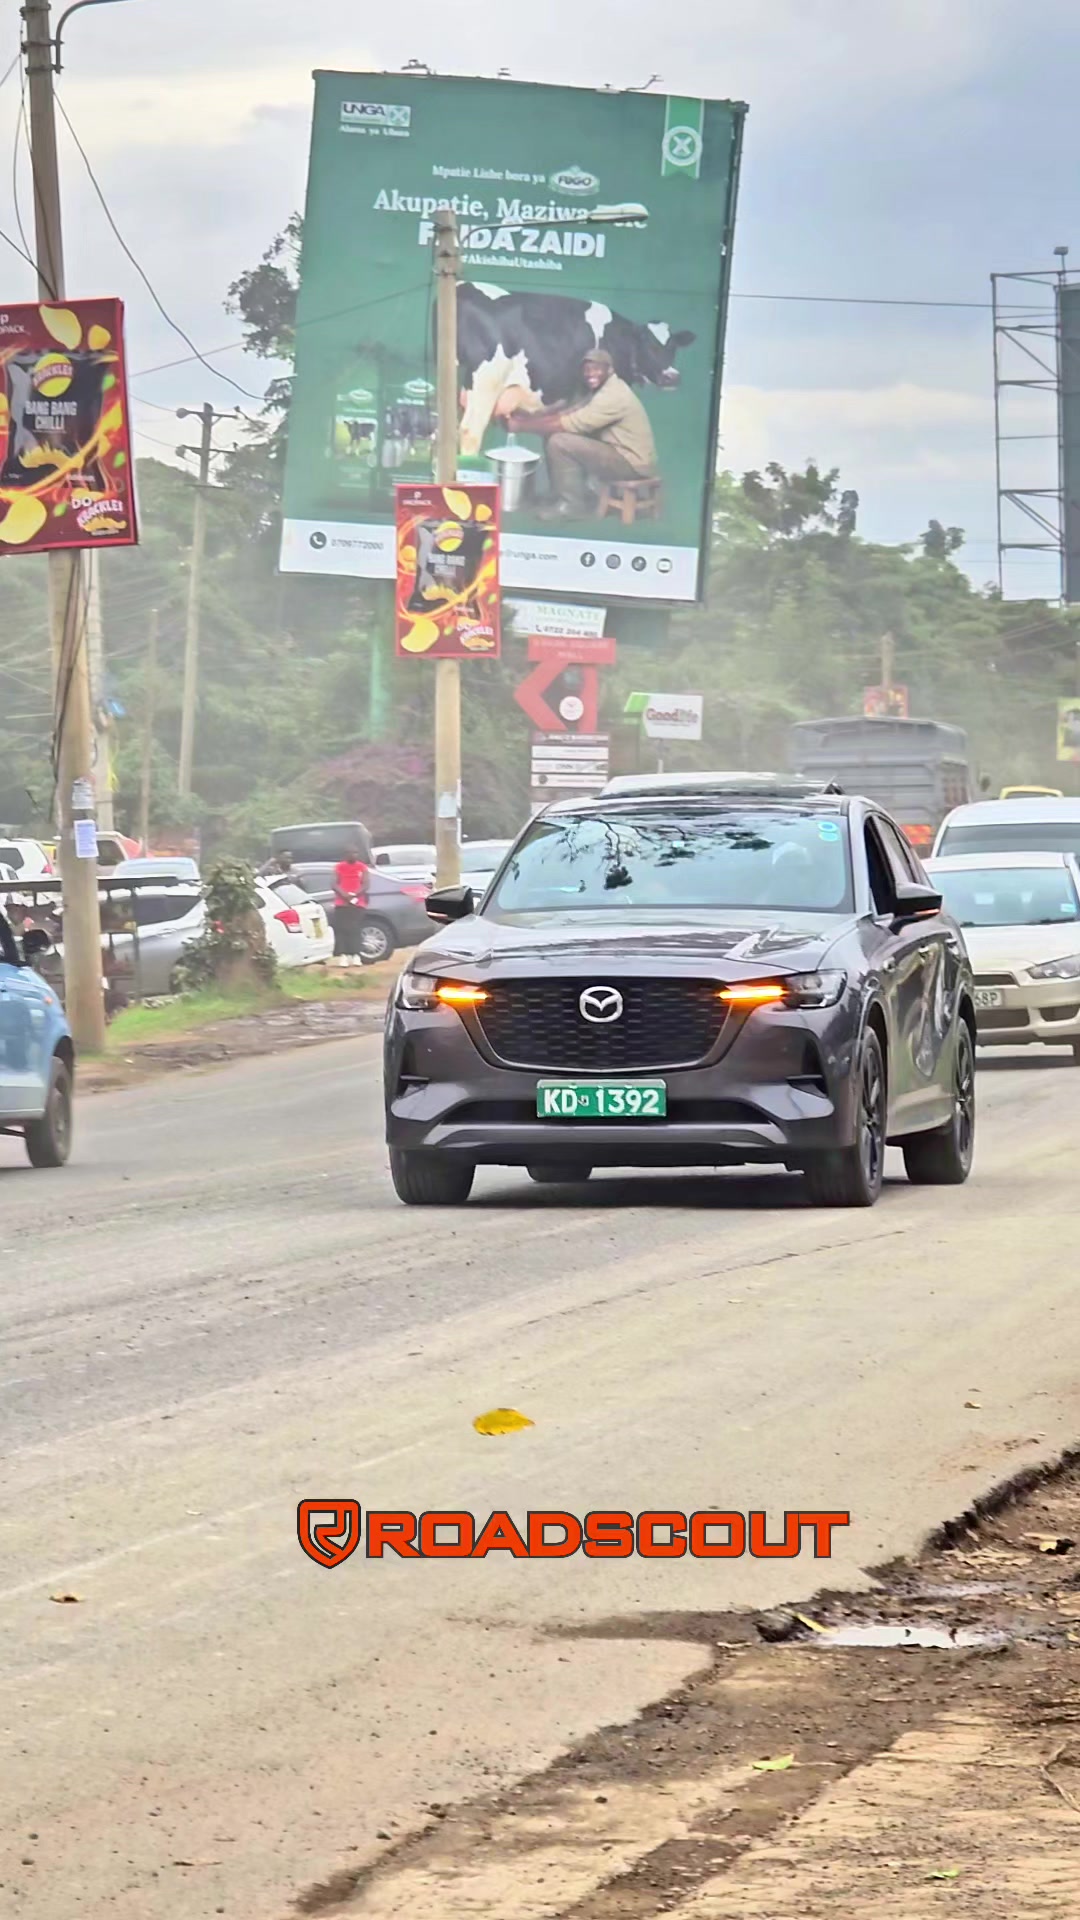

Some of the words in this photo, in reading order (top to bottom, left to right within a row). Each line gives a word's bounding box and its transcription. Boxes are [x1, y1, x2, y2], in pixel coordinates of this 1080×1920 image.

[343, 103, 386, 116] UNGA
[373, 189, 489, 221] Akupatie,
[495, 197, 590, 225] Maziwa
[520, 228, 606, 258] ZAIDI
[51, 401, 77, 416] BANG
[544, 1088, 578, 1113] KD
[595, 1089, 659, 1114] 1392
